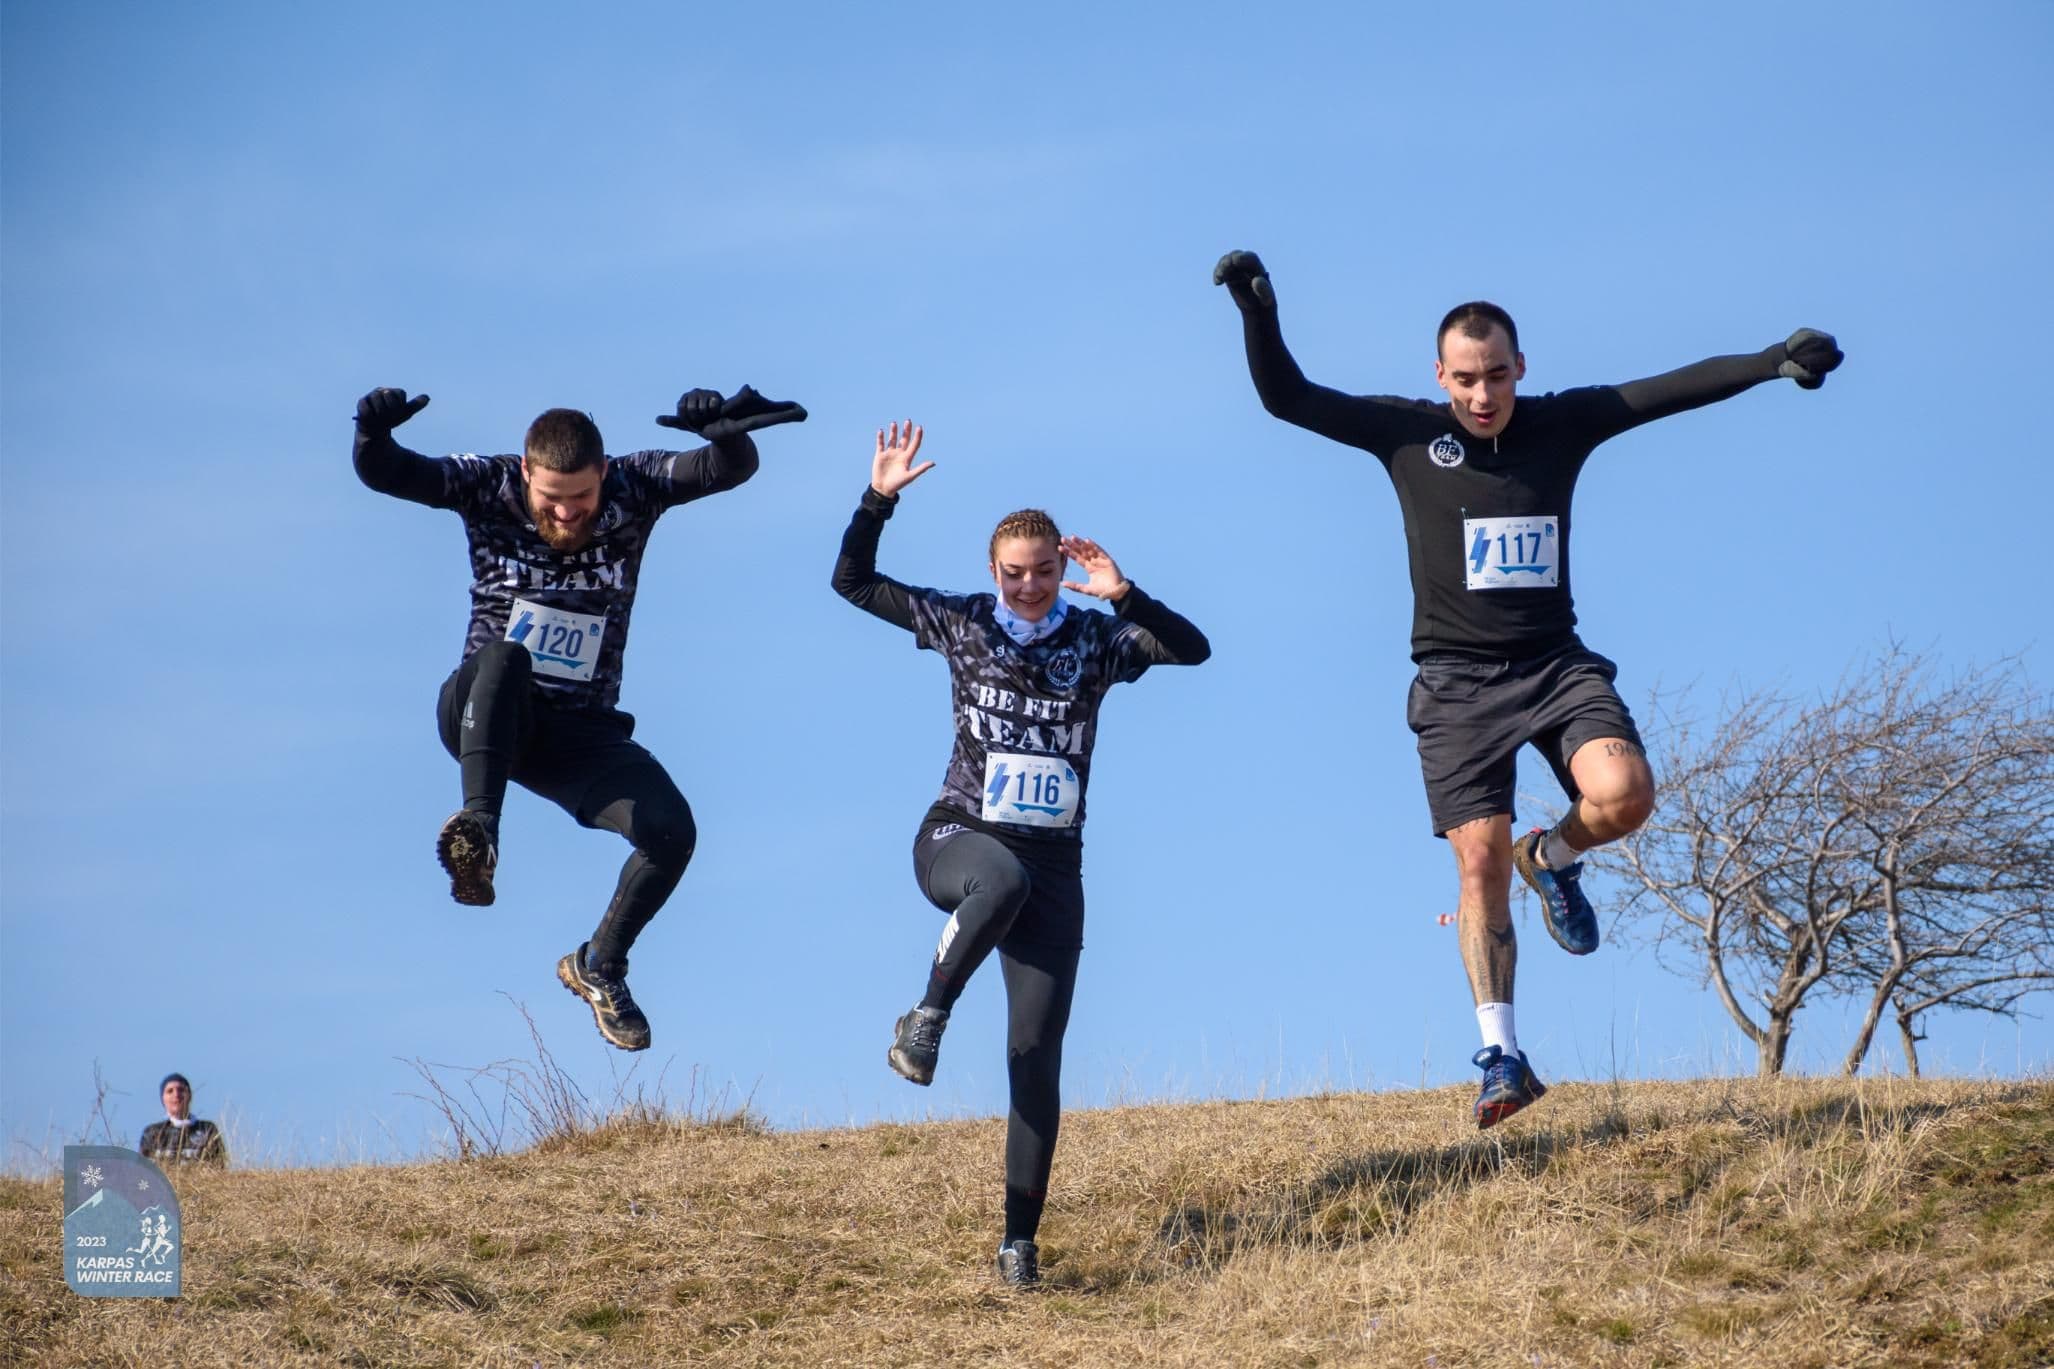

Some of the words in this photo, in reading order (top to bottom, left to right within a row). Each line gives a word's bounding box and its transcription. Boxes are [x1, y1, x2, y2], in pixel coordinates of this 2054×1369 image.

[1497, 532, 1541, 564] 117
[499, 557, 625, 591] TEAM
[538, 622, 583, 658] 120
[977, 684, 1015, 712] BE
[1023, 696, 1071, 721] FIT
[964, 703, 1087, 755] TEAM
[1017, 771, 1060, 805] 116
